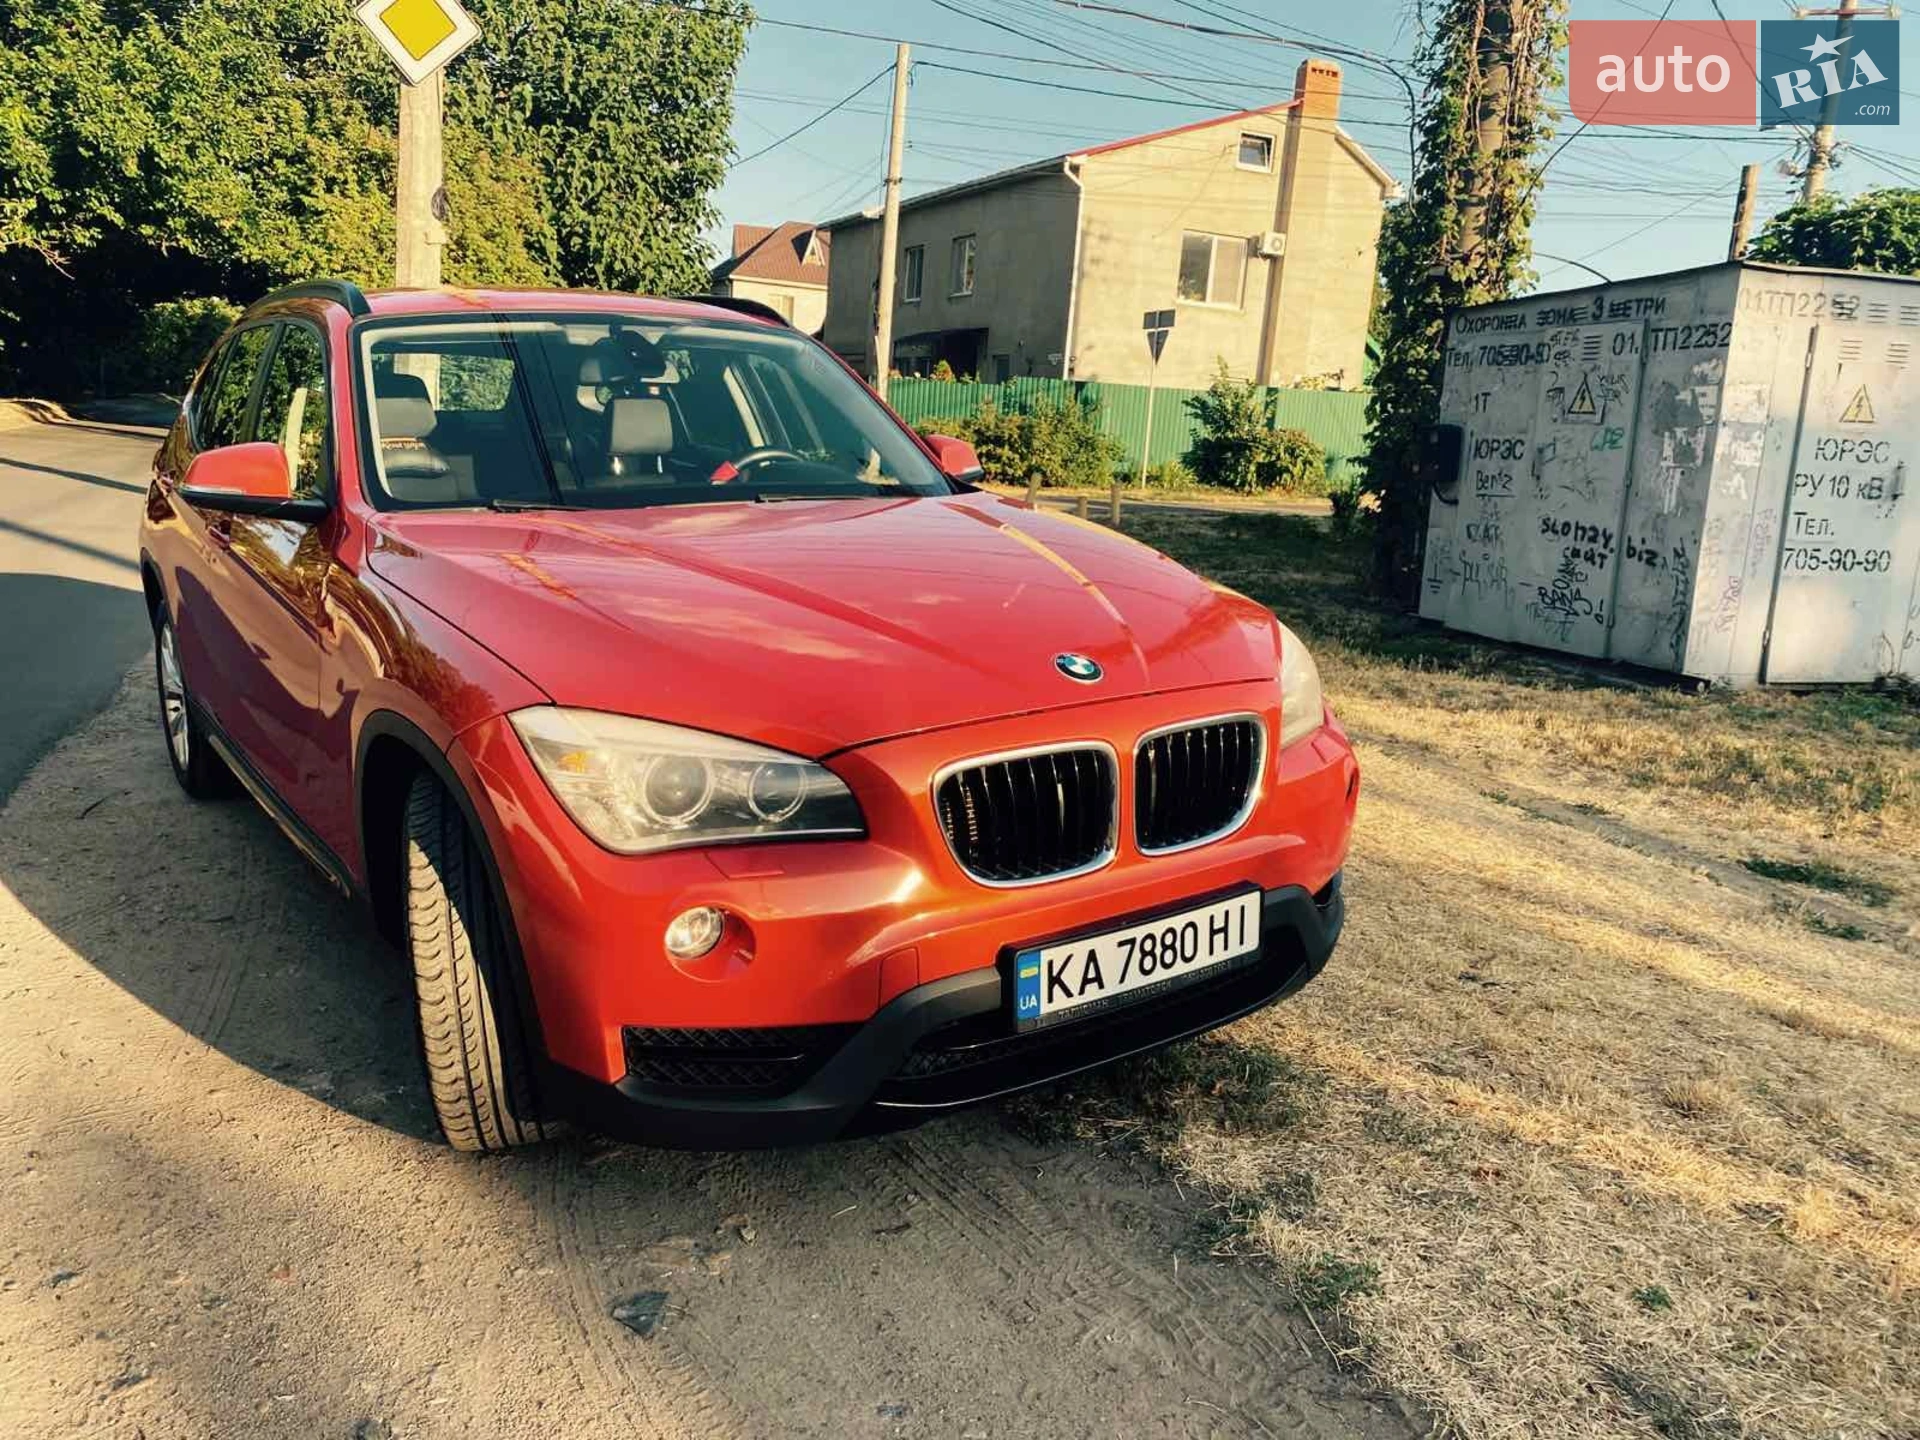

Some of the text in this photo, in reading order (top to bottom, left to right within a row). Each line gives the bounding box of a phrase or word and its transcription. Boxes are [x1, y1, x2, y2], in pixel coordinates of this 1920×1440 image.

[1591, 296, 1606, 324] 3
[1814, 437, 1892, 463] ЮРЭС
[1793, 473, 1824, 498] РУ
[1829, 474, 1850, 499] 10
[1783, 547, 1892, 573] 705-90-90
[1047, 948, 1105, 1004] KA
[1117, 921, 1199, 985] 7880
[1209, 904, 1246, 957] HI
[1019, 994, 1038, 1010] UA
